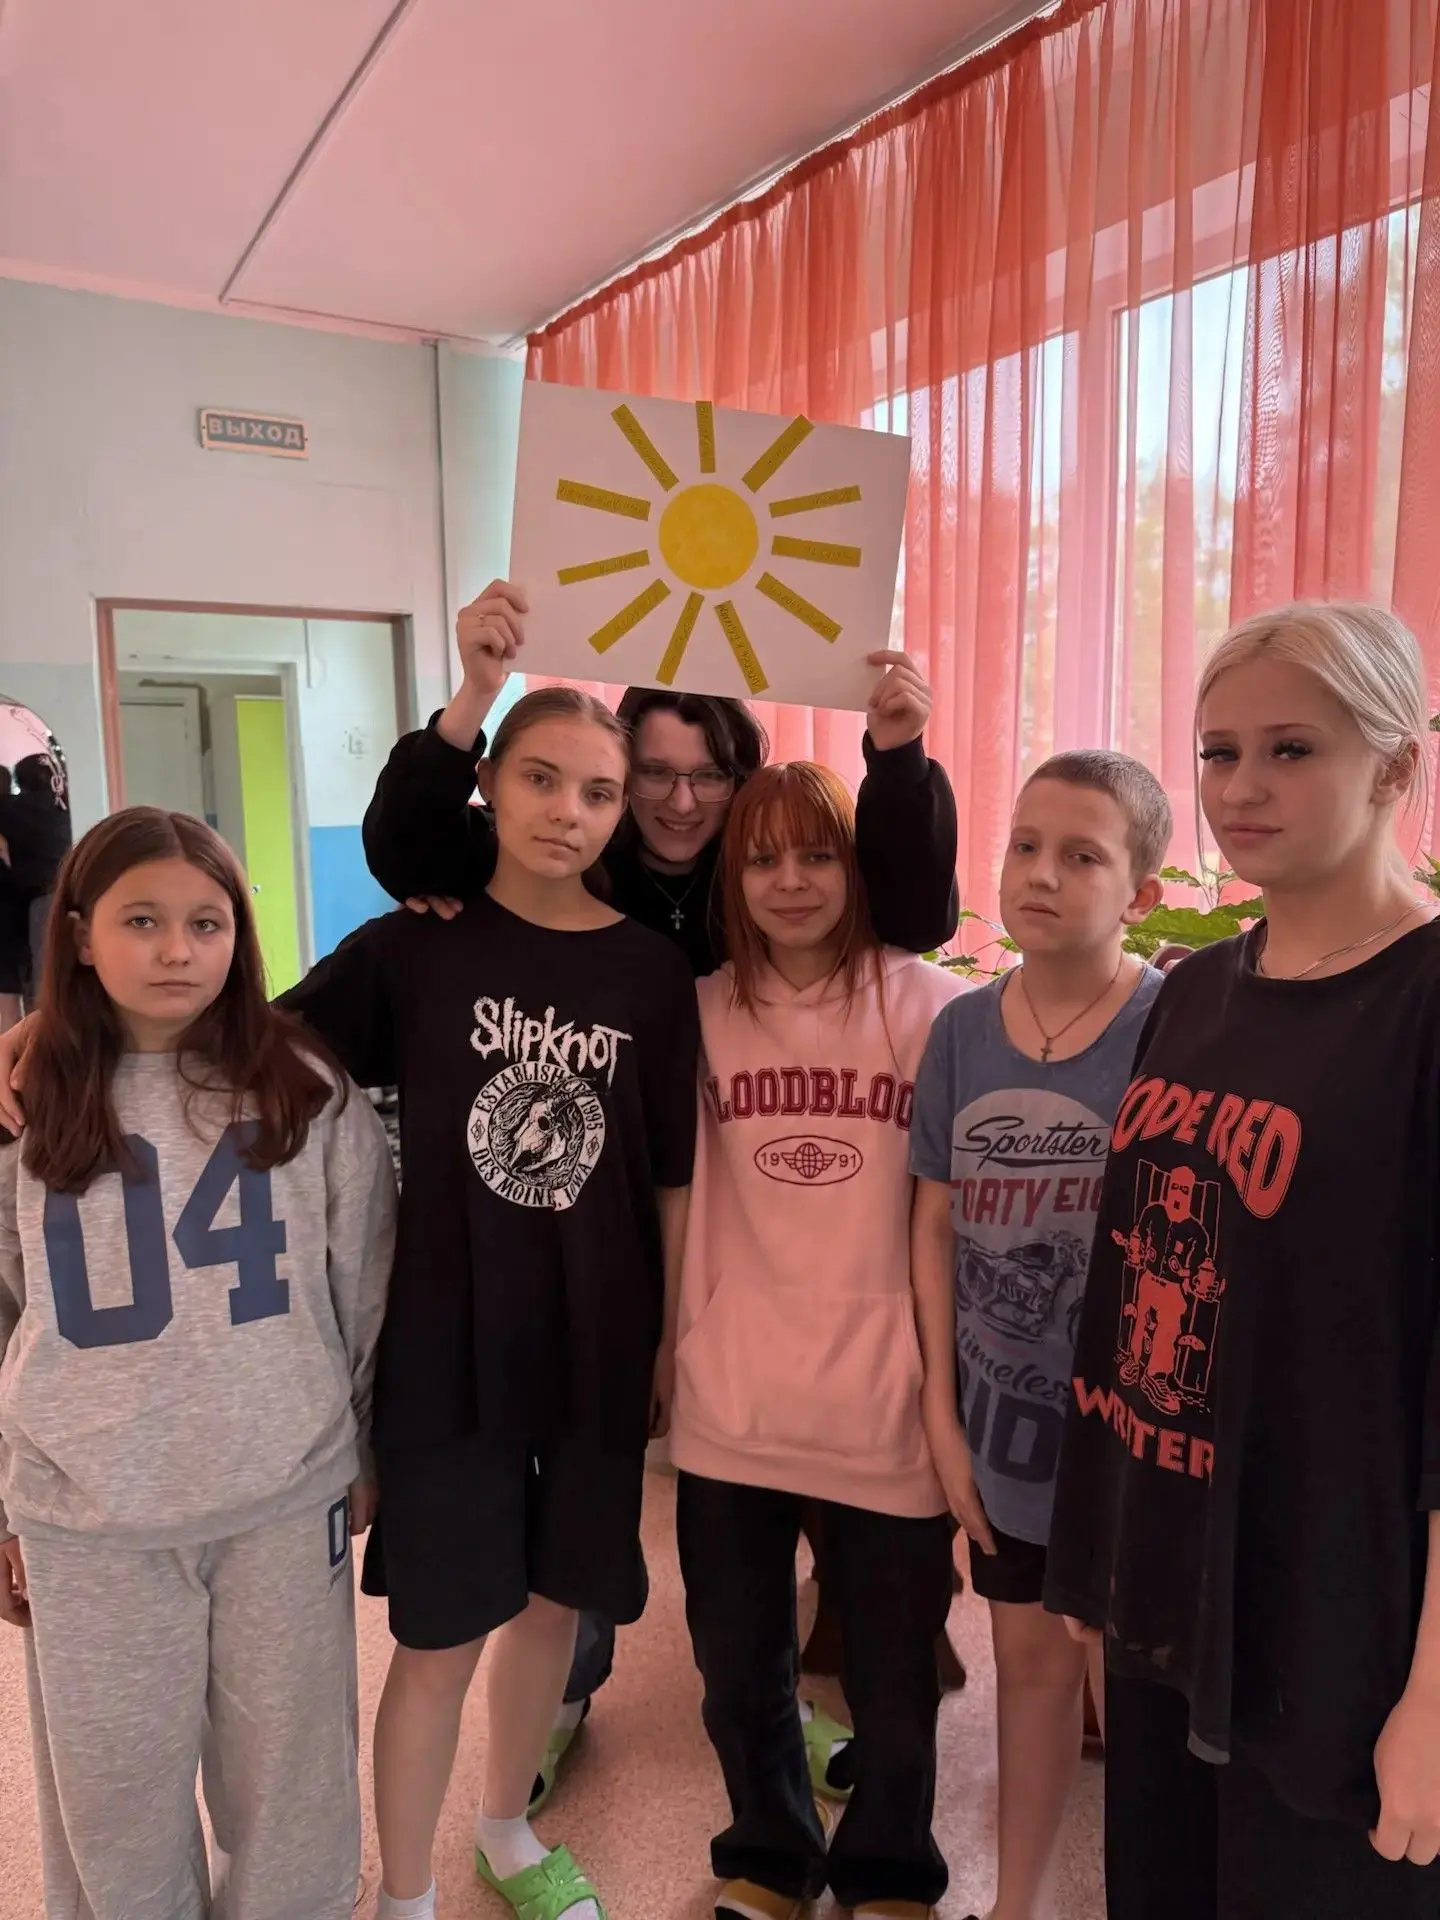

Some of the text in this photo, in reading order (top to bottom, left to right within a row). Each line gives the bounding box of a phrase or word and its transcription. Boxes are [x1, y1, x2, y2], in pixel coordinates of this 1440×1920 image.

[208, 417, 302, 448] ВЫХОД
[472, 1147, 500, 1182] DES
[563, 1163, 592, 1204] IOWA
[954, 1116, 1109, 1171] Sportster
[1206, 1092, 1301, 1219] RED
[43, 1118, 290, 1349] 04
[1072, 1377, 1216, 1488] WRITER
